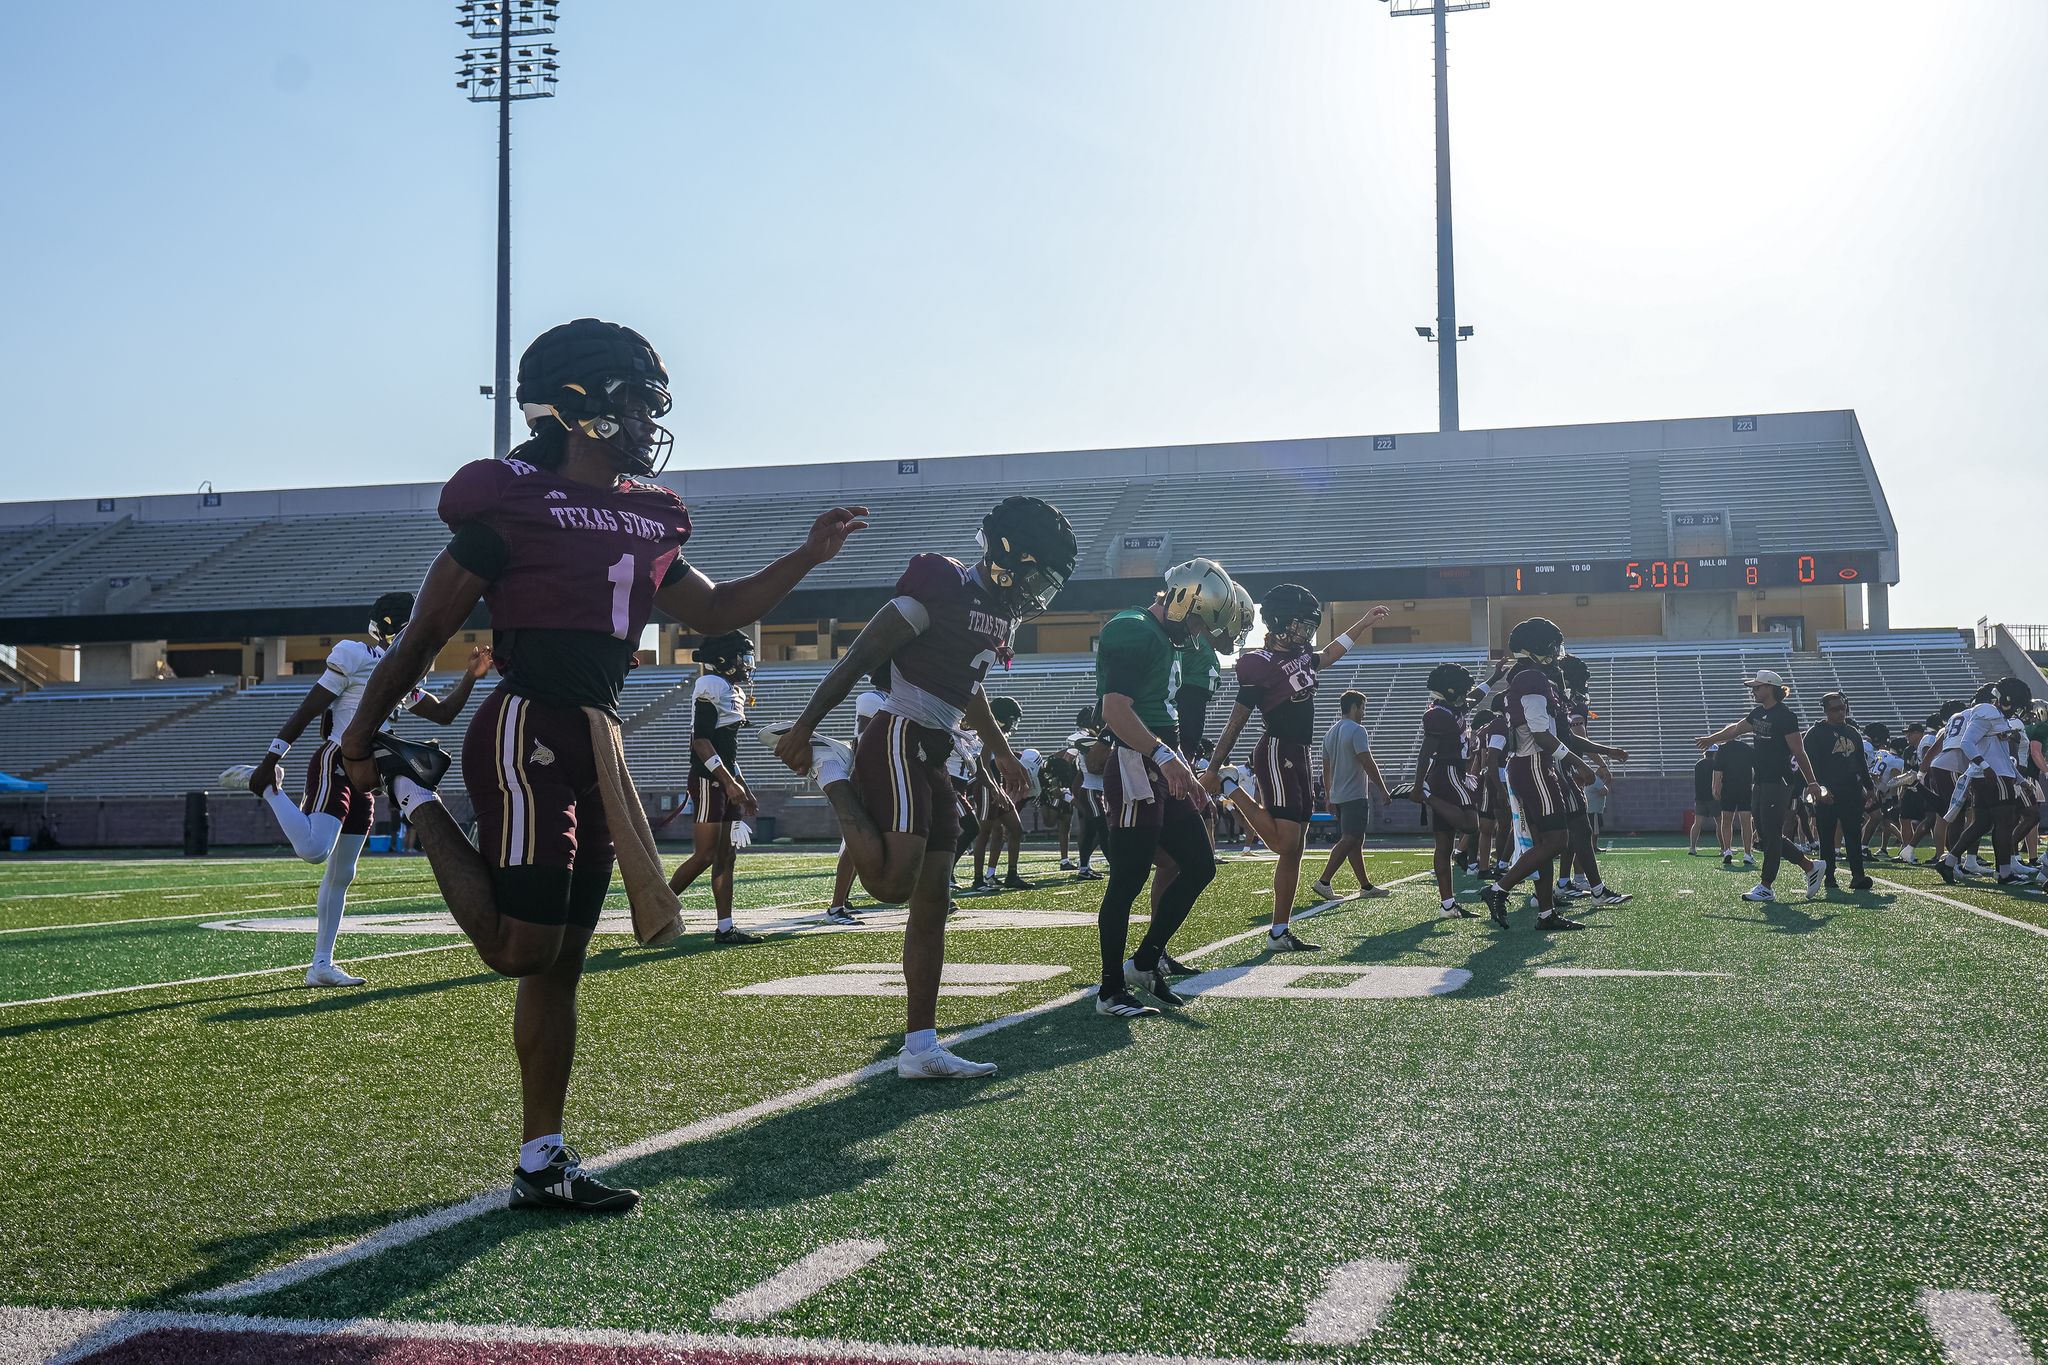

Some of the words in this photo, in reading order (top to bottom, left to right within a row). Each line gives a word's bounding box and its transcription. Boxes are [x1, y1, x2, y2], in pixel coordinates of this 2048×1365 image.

[1737, 421, 1753, 431] 223
[1377, 440, 1392, 449] 222
[902, 464, 914, 473] 221
[550, 507, 618, 532] TEXAS
[618, 510, 666, 544] STATE
[1571, 564, 1581, 573] TO
[1581, 564, 1591, 572] GO
[1699, 559, 1716, 567] BALL
[1717, 558, 1727, 567] ON
[1745, 557, 1758, 566] QTR
[1535, 564, 1555, 574] DOWN
[1626, 561, 1689, 589] 5:00
[1747, 566, 1758, 585] 8
[1799, 556, 1815, 583] 0
[1516, 568, 1522, 592] 1
[608, 553, 634, 640] 1
[967, 610, 994, 636] TEXAS
